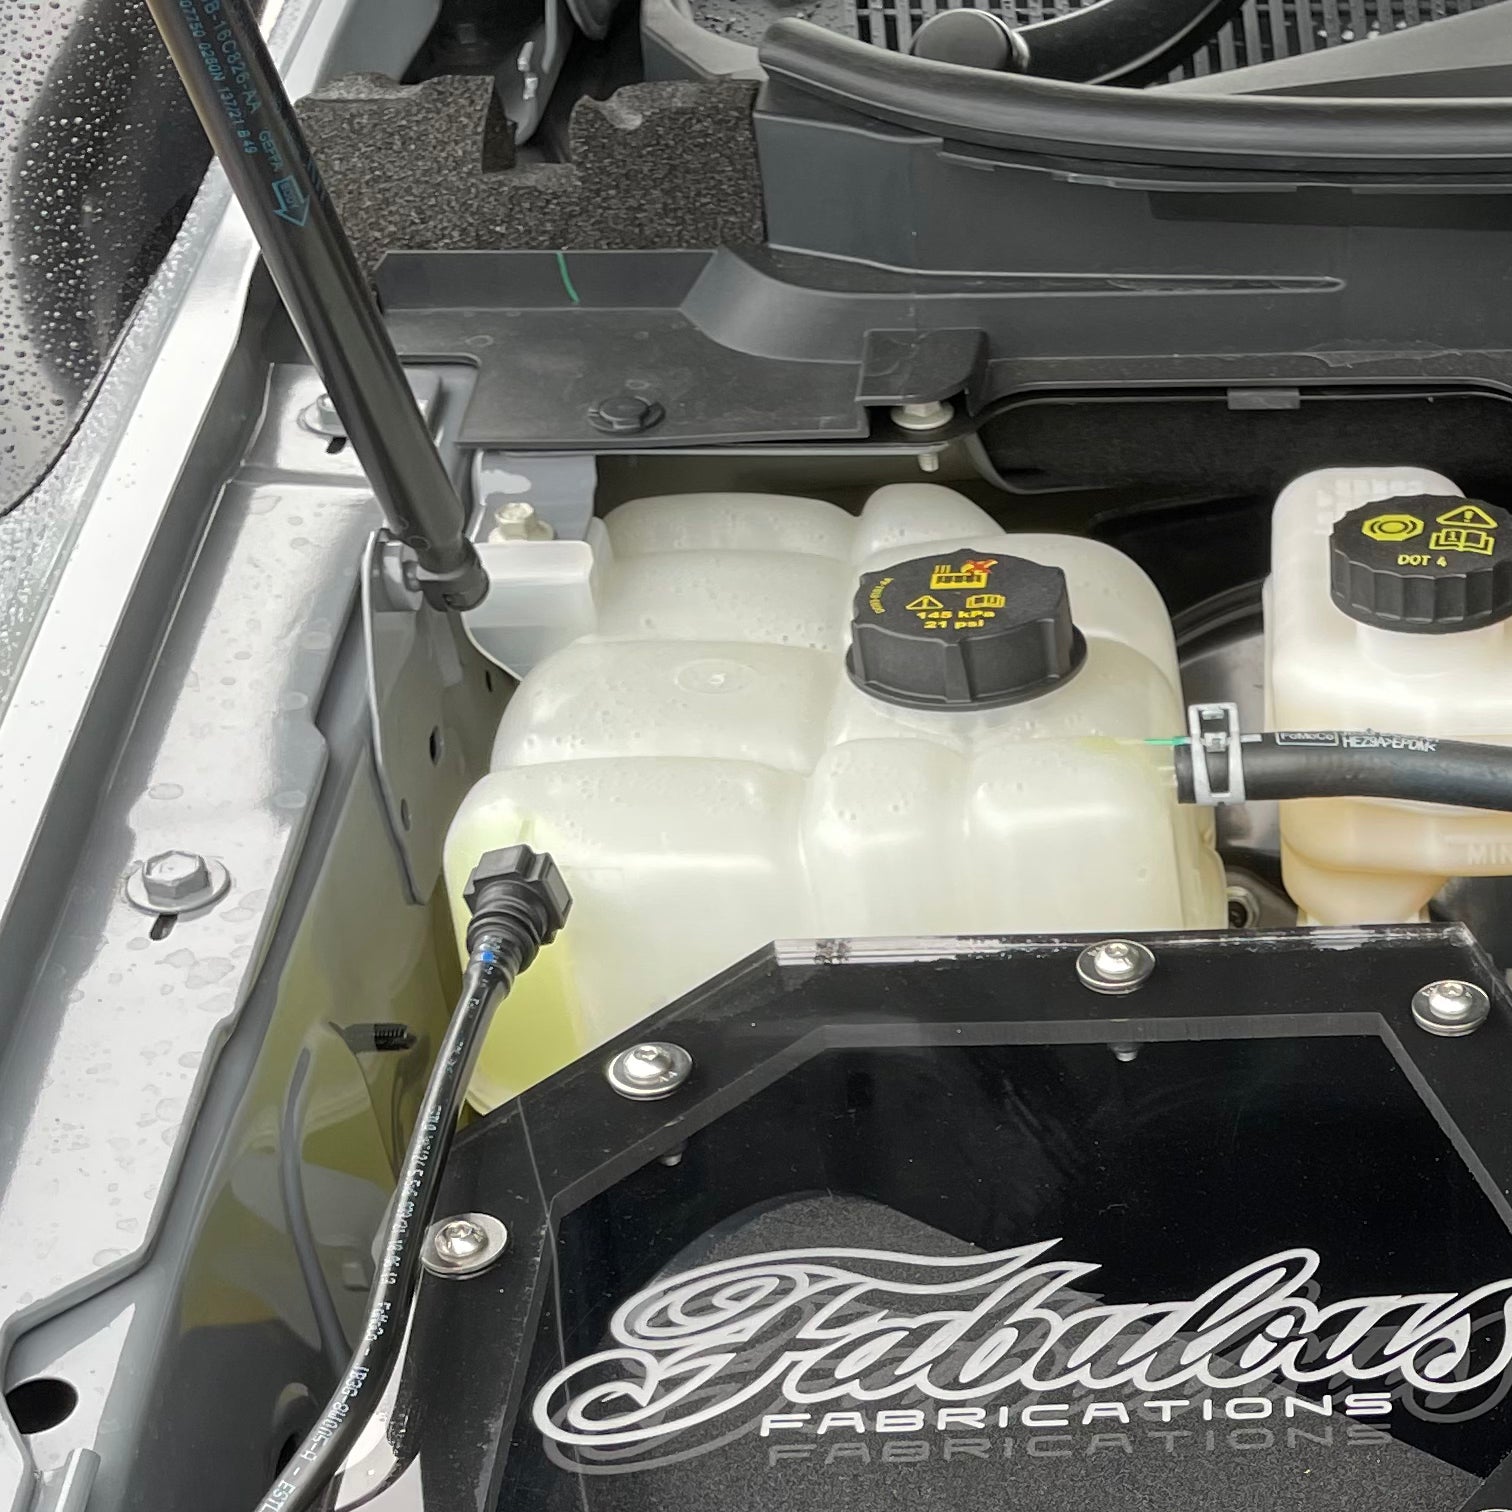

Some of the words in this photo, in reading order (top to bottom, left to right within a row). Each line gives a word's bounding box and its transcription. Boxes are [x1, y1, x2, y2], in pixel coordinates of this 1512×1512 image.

[1397, 553, 1432, 566] DOT
[1436, 555, 1448, 567] 4
[916, 610, 953, 620] 145
[957, 610, 996, 619] kPa
[923, 620, 948, 629] 21
[953, 619, 985, 630] psi
[759, 1391, 1394, 1436] FABRICATIONS
